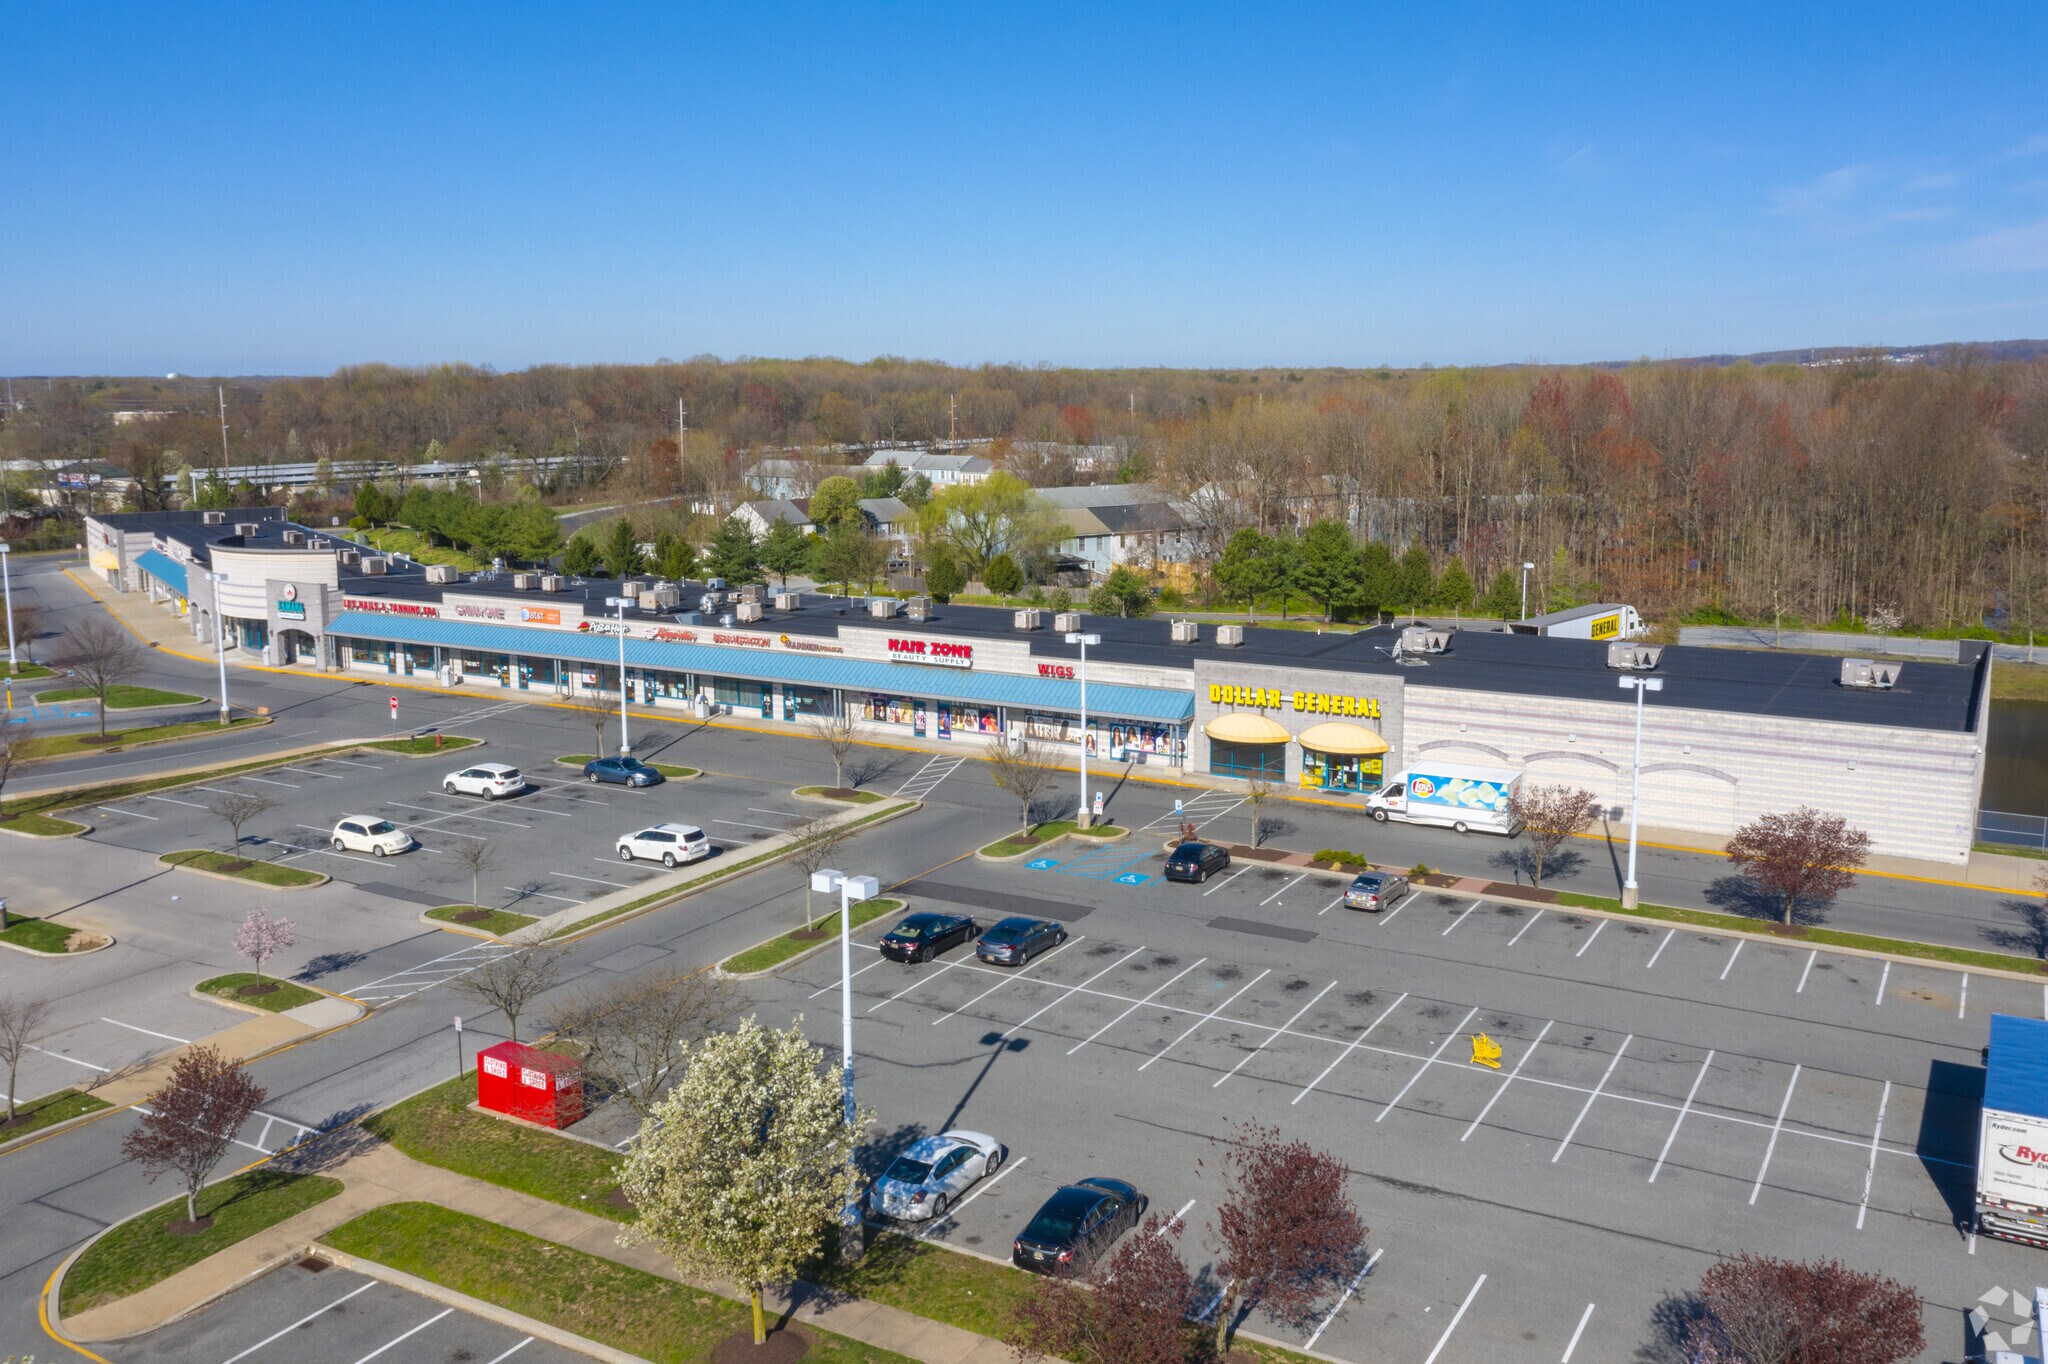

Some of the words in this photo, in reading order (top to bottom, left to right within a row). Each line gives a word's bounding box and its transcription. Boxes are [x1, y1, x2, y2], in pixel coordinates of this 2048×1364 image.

[358, 601, 379, 611] NAILS
[389, 603, 420, 615] TANNING
[422, 606, 438, 616] SPA
[590, 622, 611, 632] Pizza
[1591, 618, 1617, 638] GENERAL
[888, 638, 926, 655] HAIR
[930, 642, 973, 659] ZONE
[892, 653, 927, 661] BEAUTY
[934, 657, 965, 665] SUPPLY
[1037, 663, 1074, 677] WIGS
[1209, 683, 1282, 709] DOLLAR
[1293, 690, 1381, 718] GENERAL
[1992, 1122, 2027, 1134] Ryder.com
